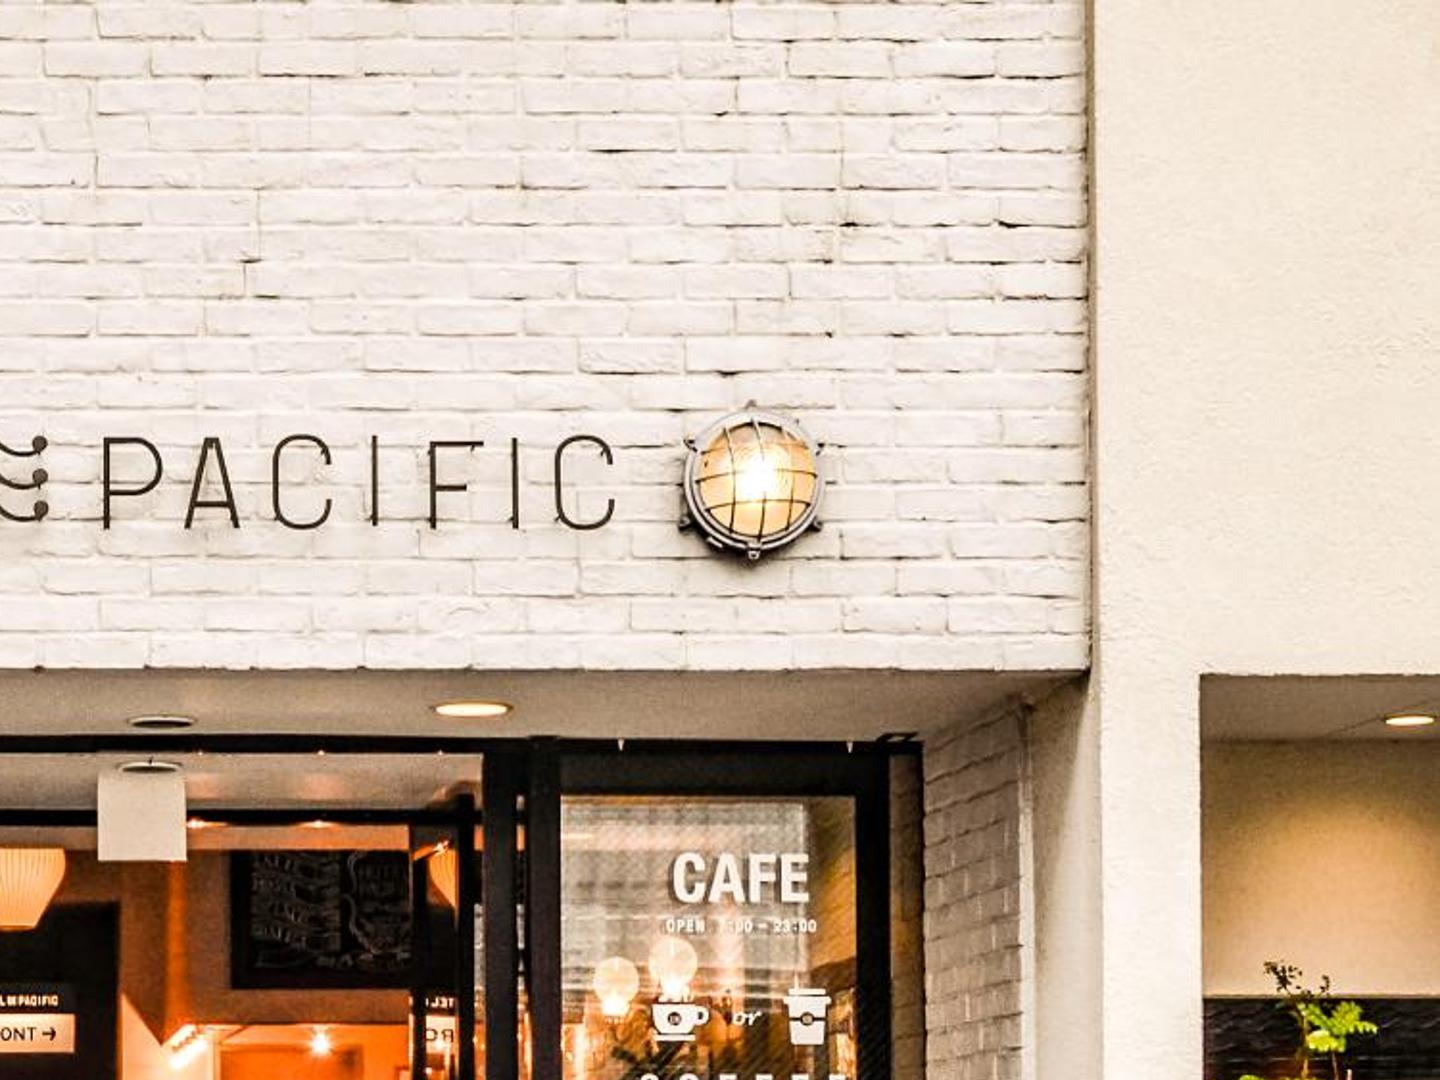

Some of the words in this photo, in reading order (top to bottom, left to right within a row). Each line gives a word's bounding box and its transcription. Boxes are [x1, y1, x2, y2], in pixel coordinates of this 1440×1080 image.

[103, 434, 615, 531] PACIFIC
[672, 853, 810, 903] CAFE
[666, 918, 706, 933] OPEN
[731, 1010, 762, 1026] or
